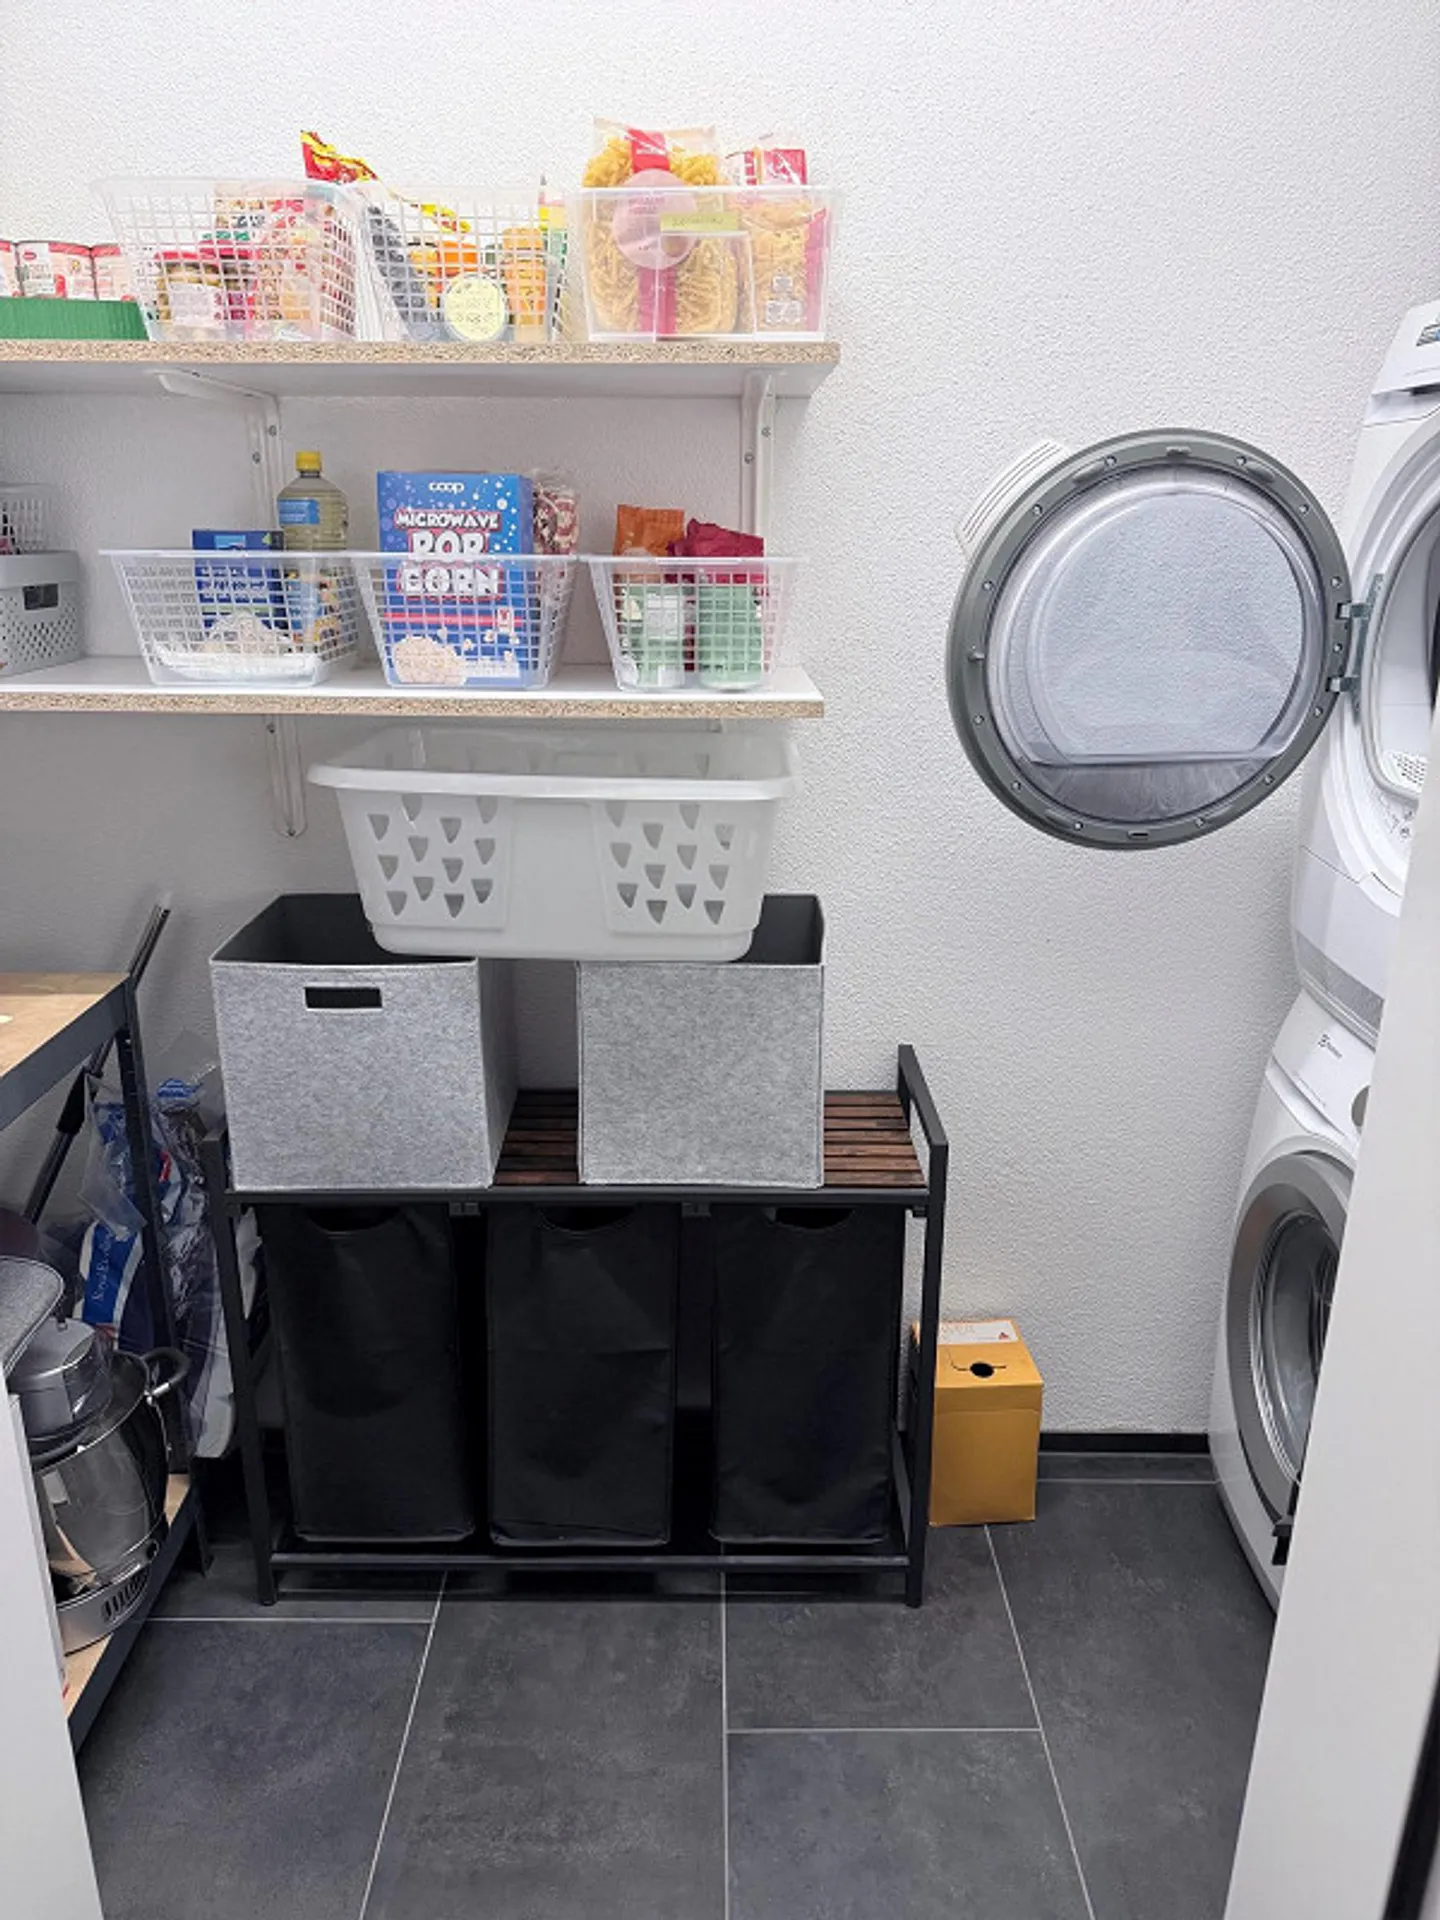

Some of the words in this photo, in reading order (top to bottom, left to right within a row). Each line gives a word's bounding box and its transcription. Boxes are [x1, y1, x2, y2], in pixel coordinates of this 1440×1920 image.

[429, 482, 465, 494] coop
[397, 511, 499, 528] MICROWAVE
[412, 530, 485, 559] POP
[401, 567, 499, 597] CORN
